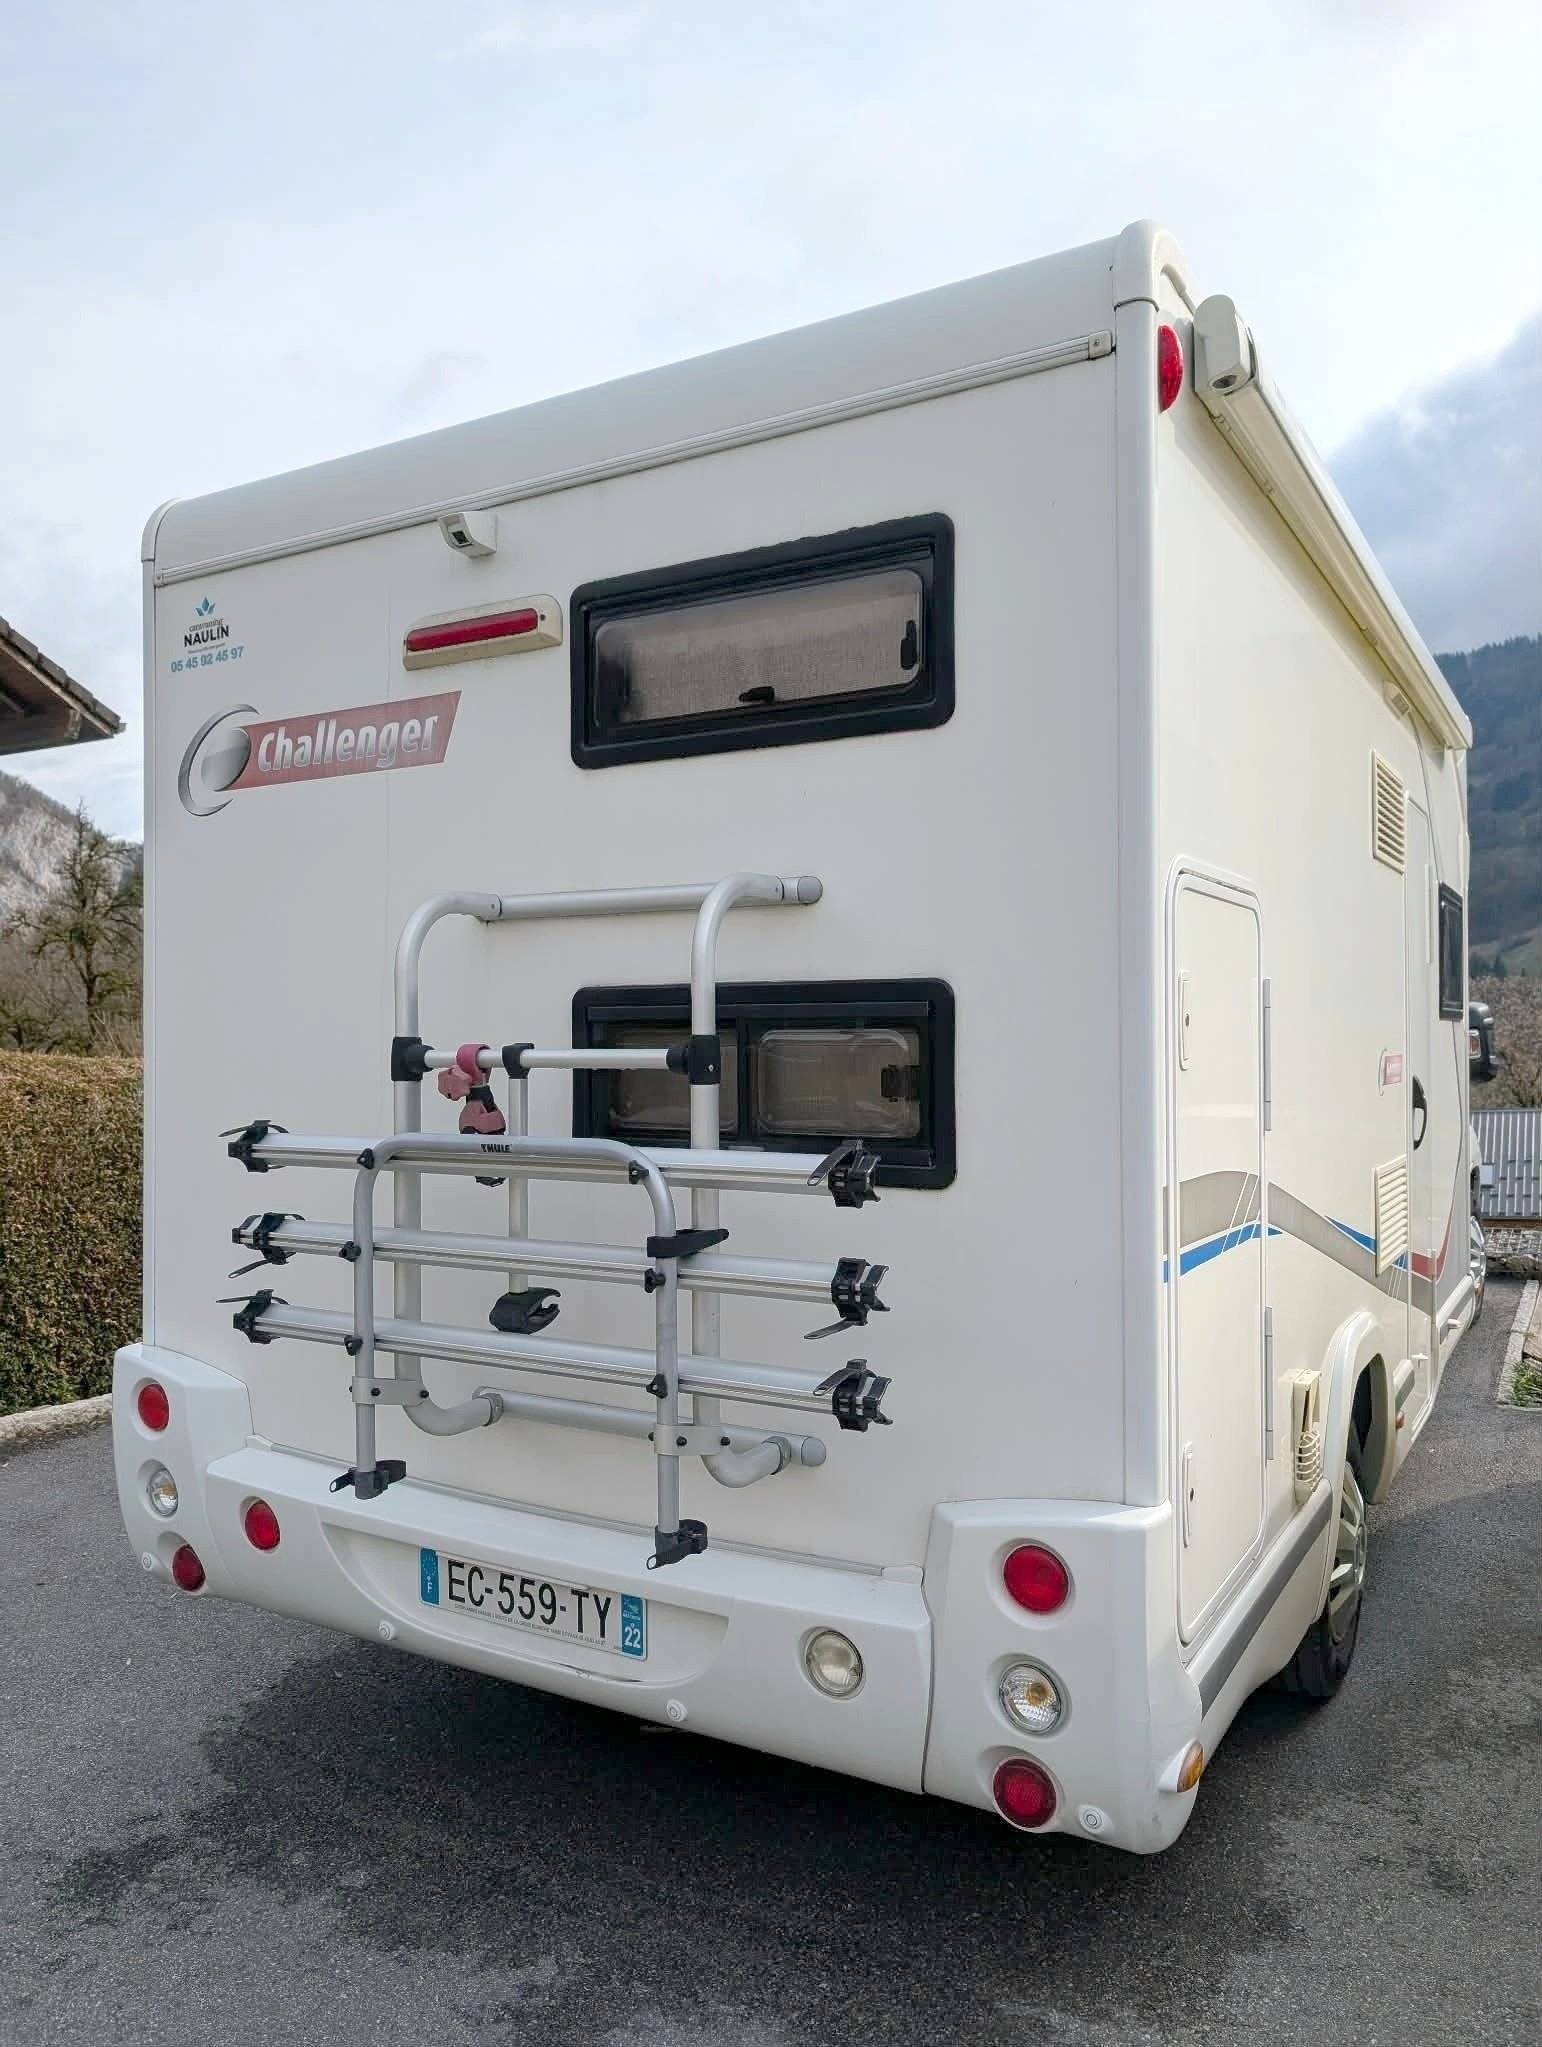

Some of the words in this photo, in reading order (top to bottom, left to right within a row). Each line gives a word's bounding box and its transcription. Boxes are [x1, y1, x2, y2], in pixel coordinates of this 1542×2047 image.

[184, 625, 229, 647] NAULIN
[171, 660, 184, 673] 05
[185, 656, 198, 670] 45
[215, 649, 229, 662] 45
[231, 646, 245, 659] 97
[257, 715, 439, 773] Challenger
[480, 1143, 512, 1153] THULE
[427, 1582, 433, 1593] F
[447, 1559, 612, 1639] EC-559-TY
[624, 1626, 641, 1648] 22
